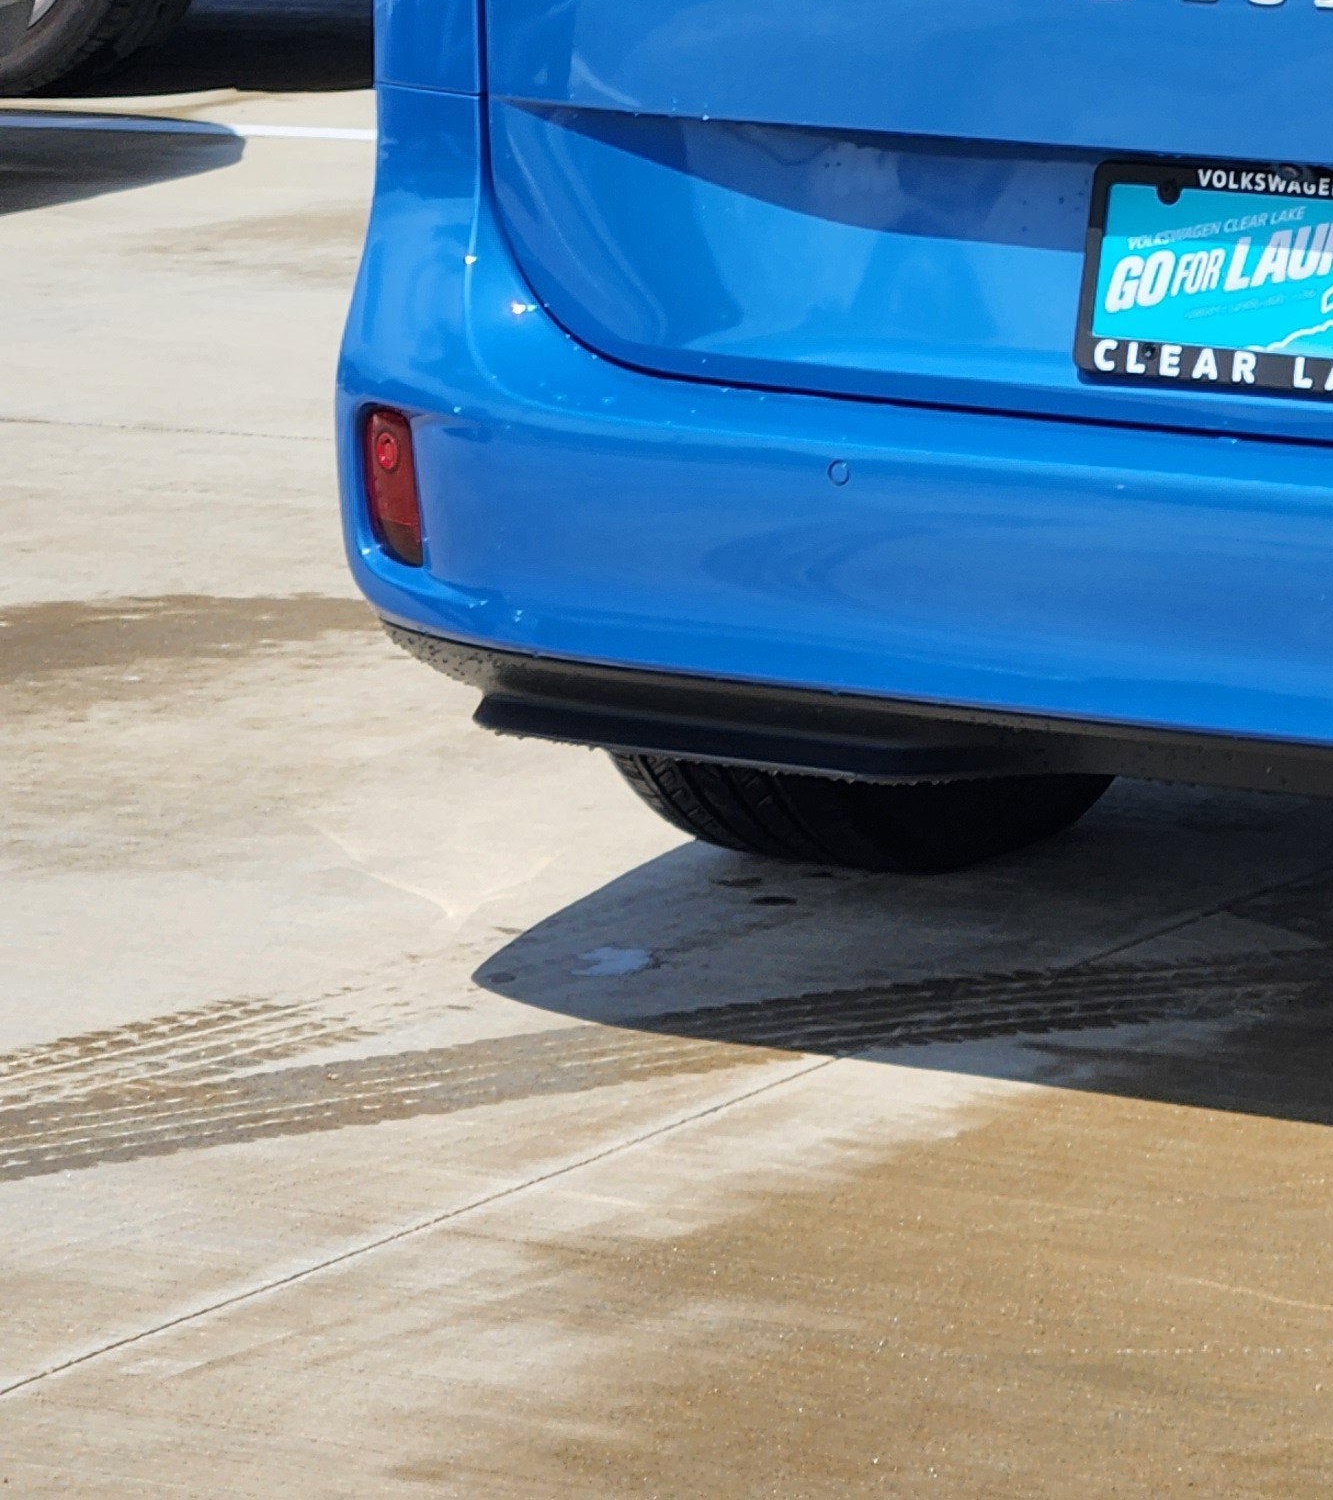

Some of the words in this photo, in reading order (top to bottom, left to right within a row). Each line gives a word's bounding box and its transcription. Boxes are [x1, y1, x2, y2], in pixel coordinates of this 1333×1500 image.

[1127, 221, 1222, 250] VOLKSWAGEN
[1223, 213, 1268, 233] CLEAR
[1270, 206, 1307, 225] LAKE
[1105, 250, 1176, 313] GO
[1170, 247, 1227, 298] FOR
[1093, 338, 1257, 385] CLEAR
